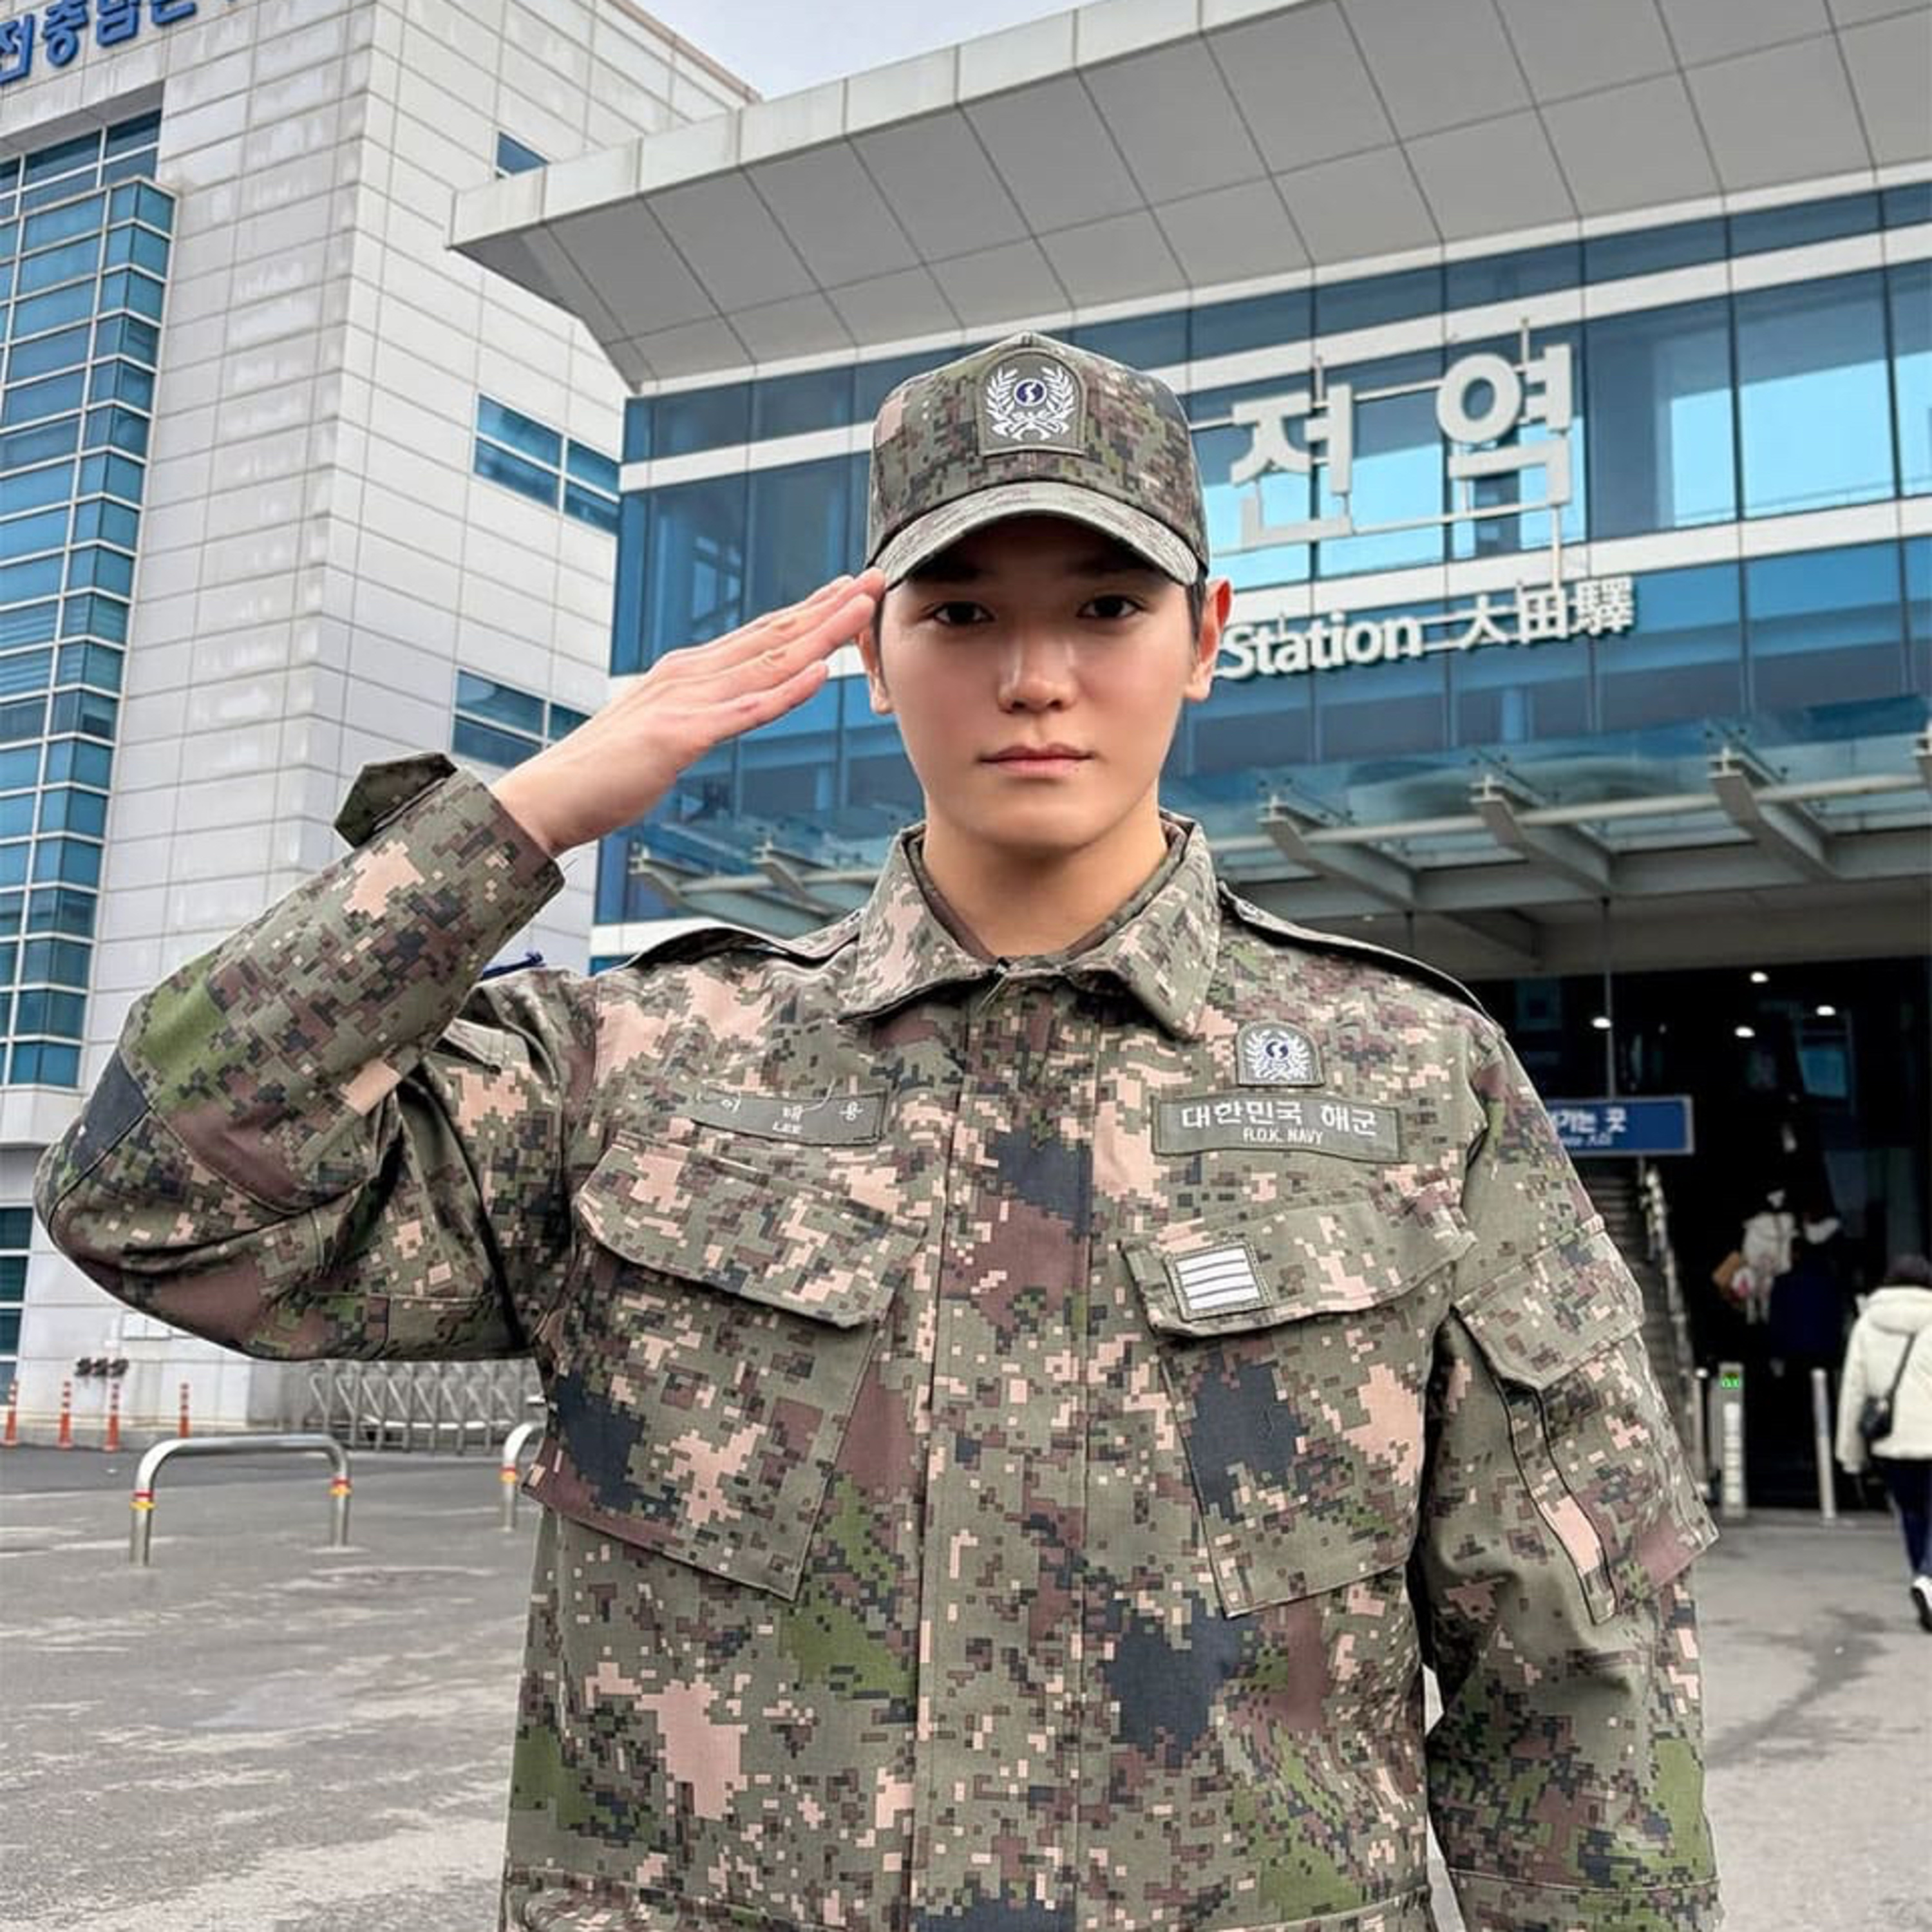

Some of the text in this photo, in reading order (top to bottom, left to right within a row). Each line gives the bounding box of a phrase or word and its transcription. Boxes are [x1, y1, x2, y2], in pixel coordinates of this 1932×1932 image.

[1231, 344, 1571, 550] 전역
[1213, 611, 1422, 679] Station
[1181, 1101, 1378, 1137] 대한민국 해군
[1287, 1128, 1323, 1145] NAVY
